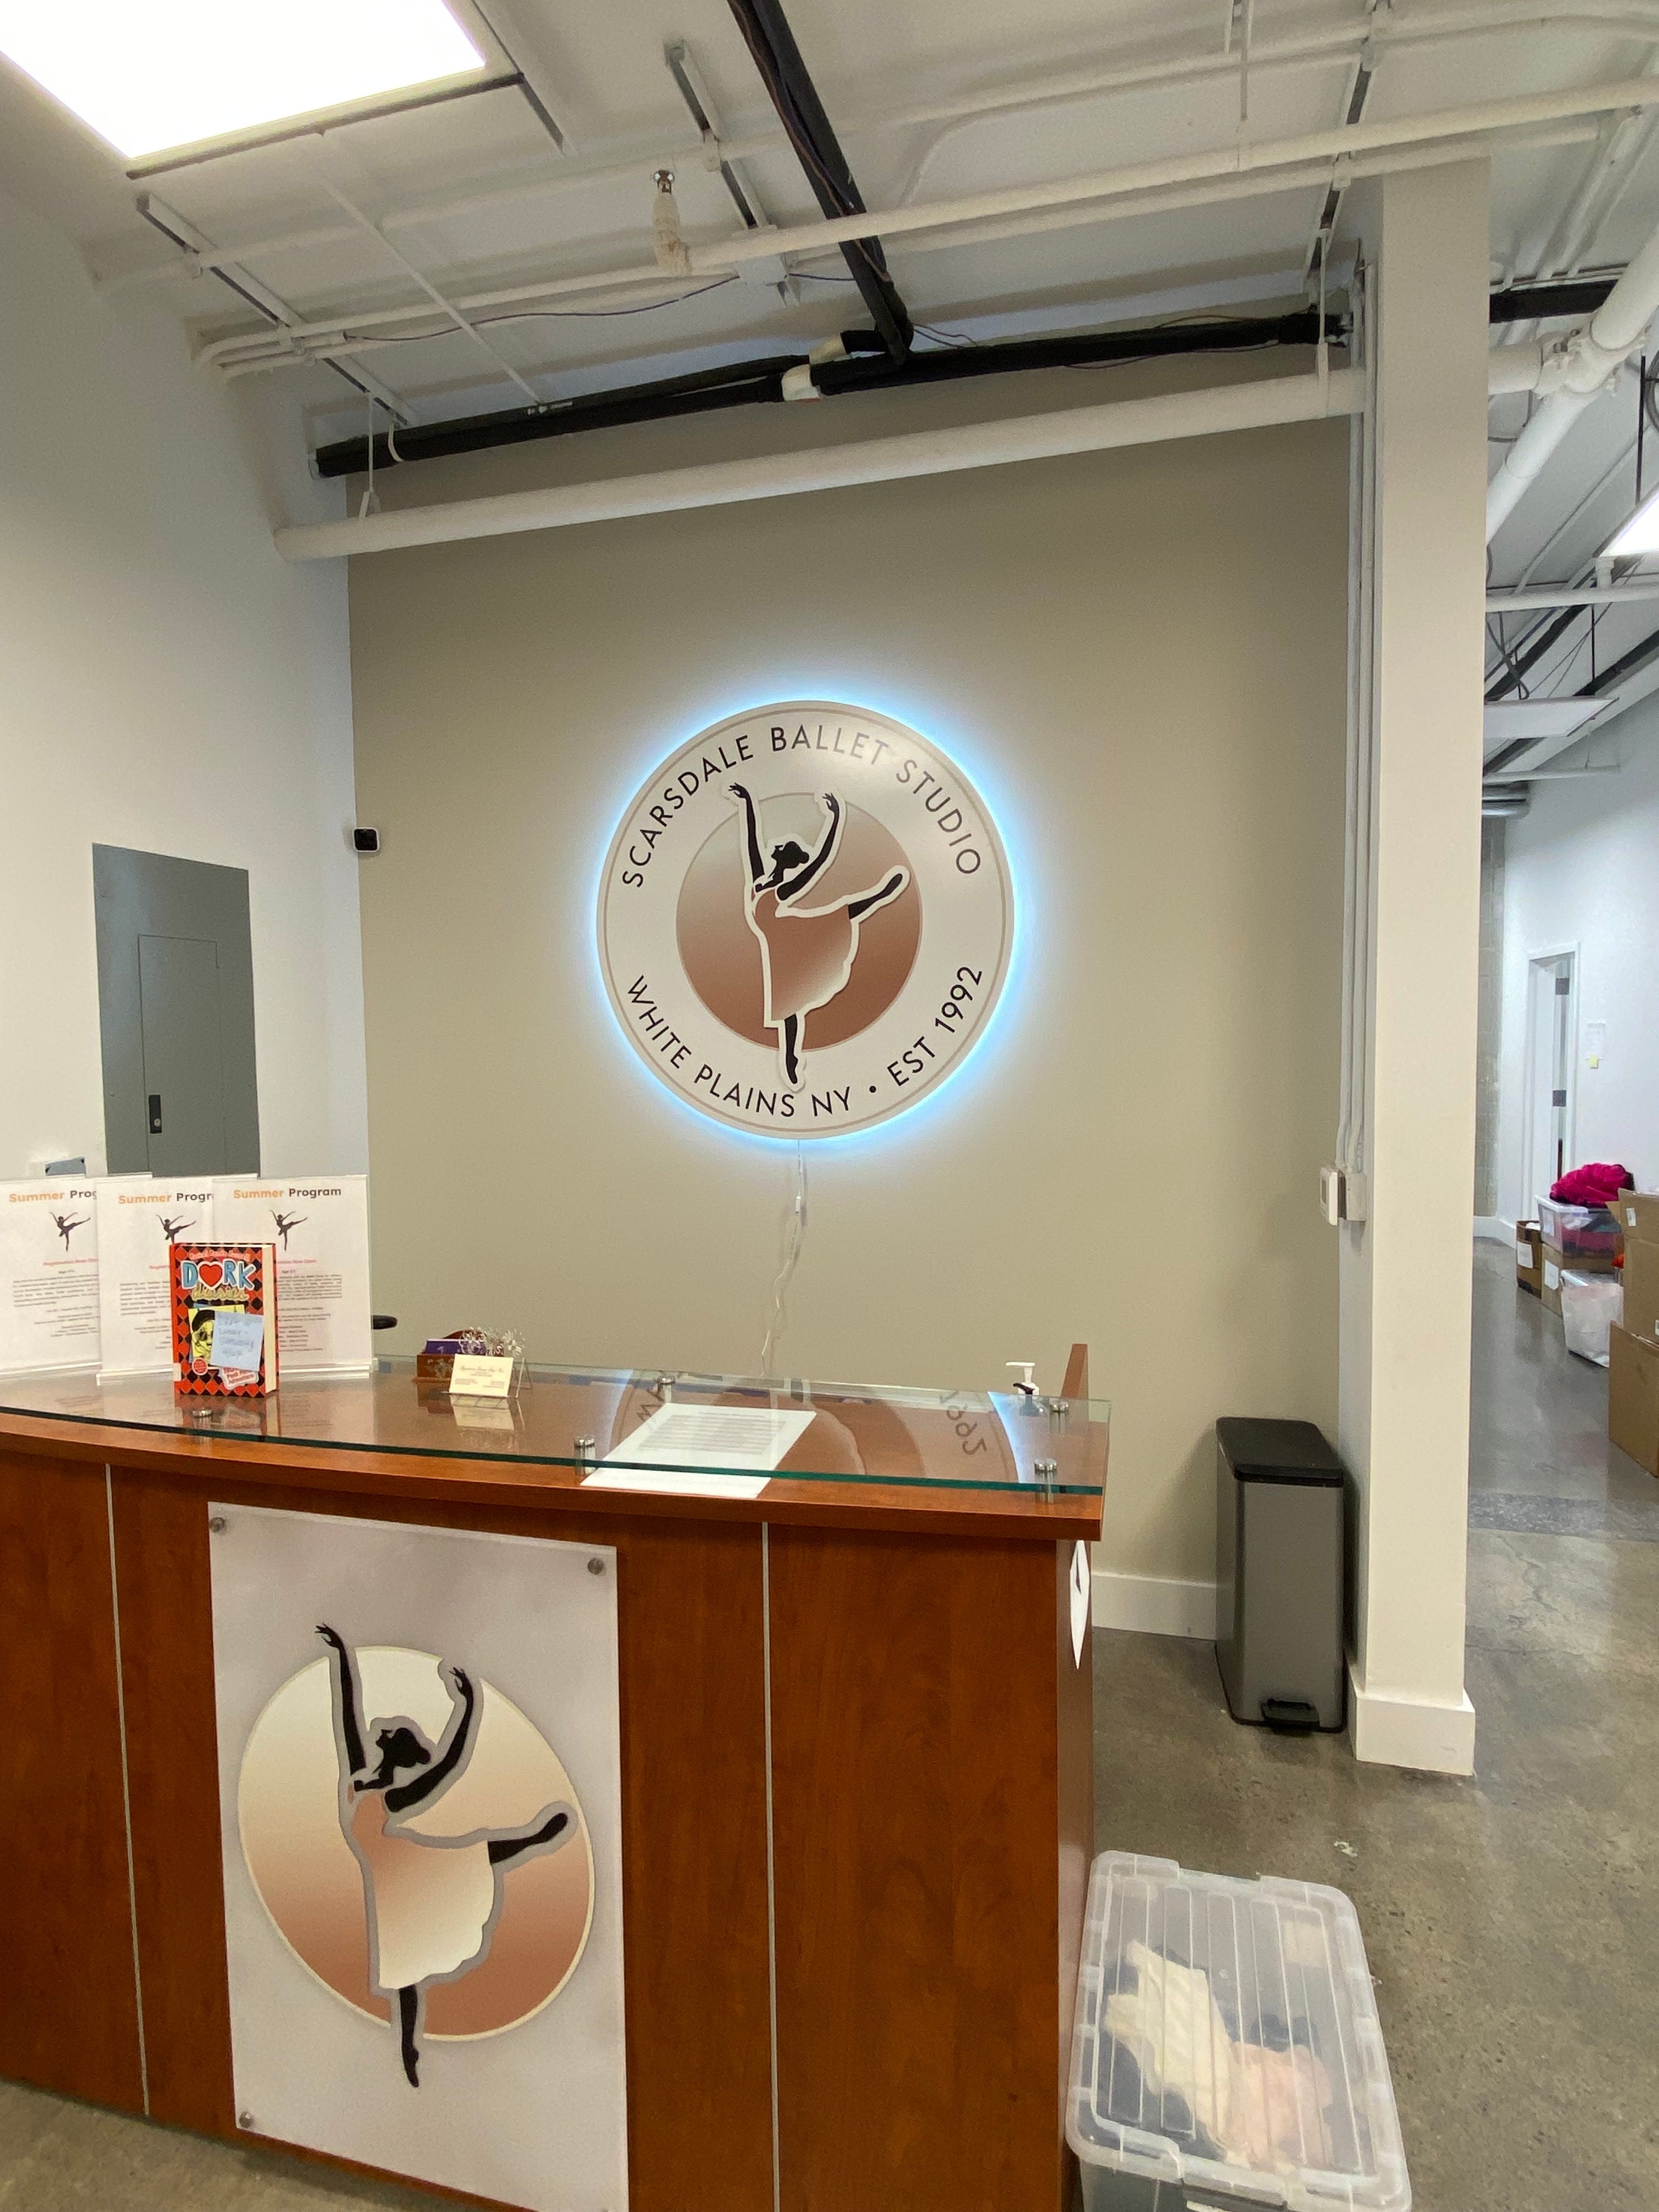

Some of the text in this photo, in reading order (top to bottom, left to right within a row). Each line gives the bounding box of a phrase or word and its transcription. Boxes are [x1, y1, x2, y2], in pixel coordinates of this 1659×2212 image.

[623, 725, 981, 888] SCARSDALE BALLET STUDIO
[628, 966, 982, 1118] WHITE PLAINS NY EST 1992
[9, 1192, 65, 1203] Summer
[233, 1188, 341, 1199] Summer Program
[118, 1195, 172, 1204] Summer
